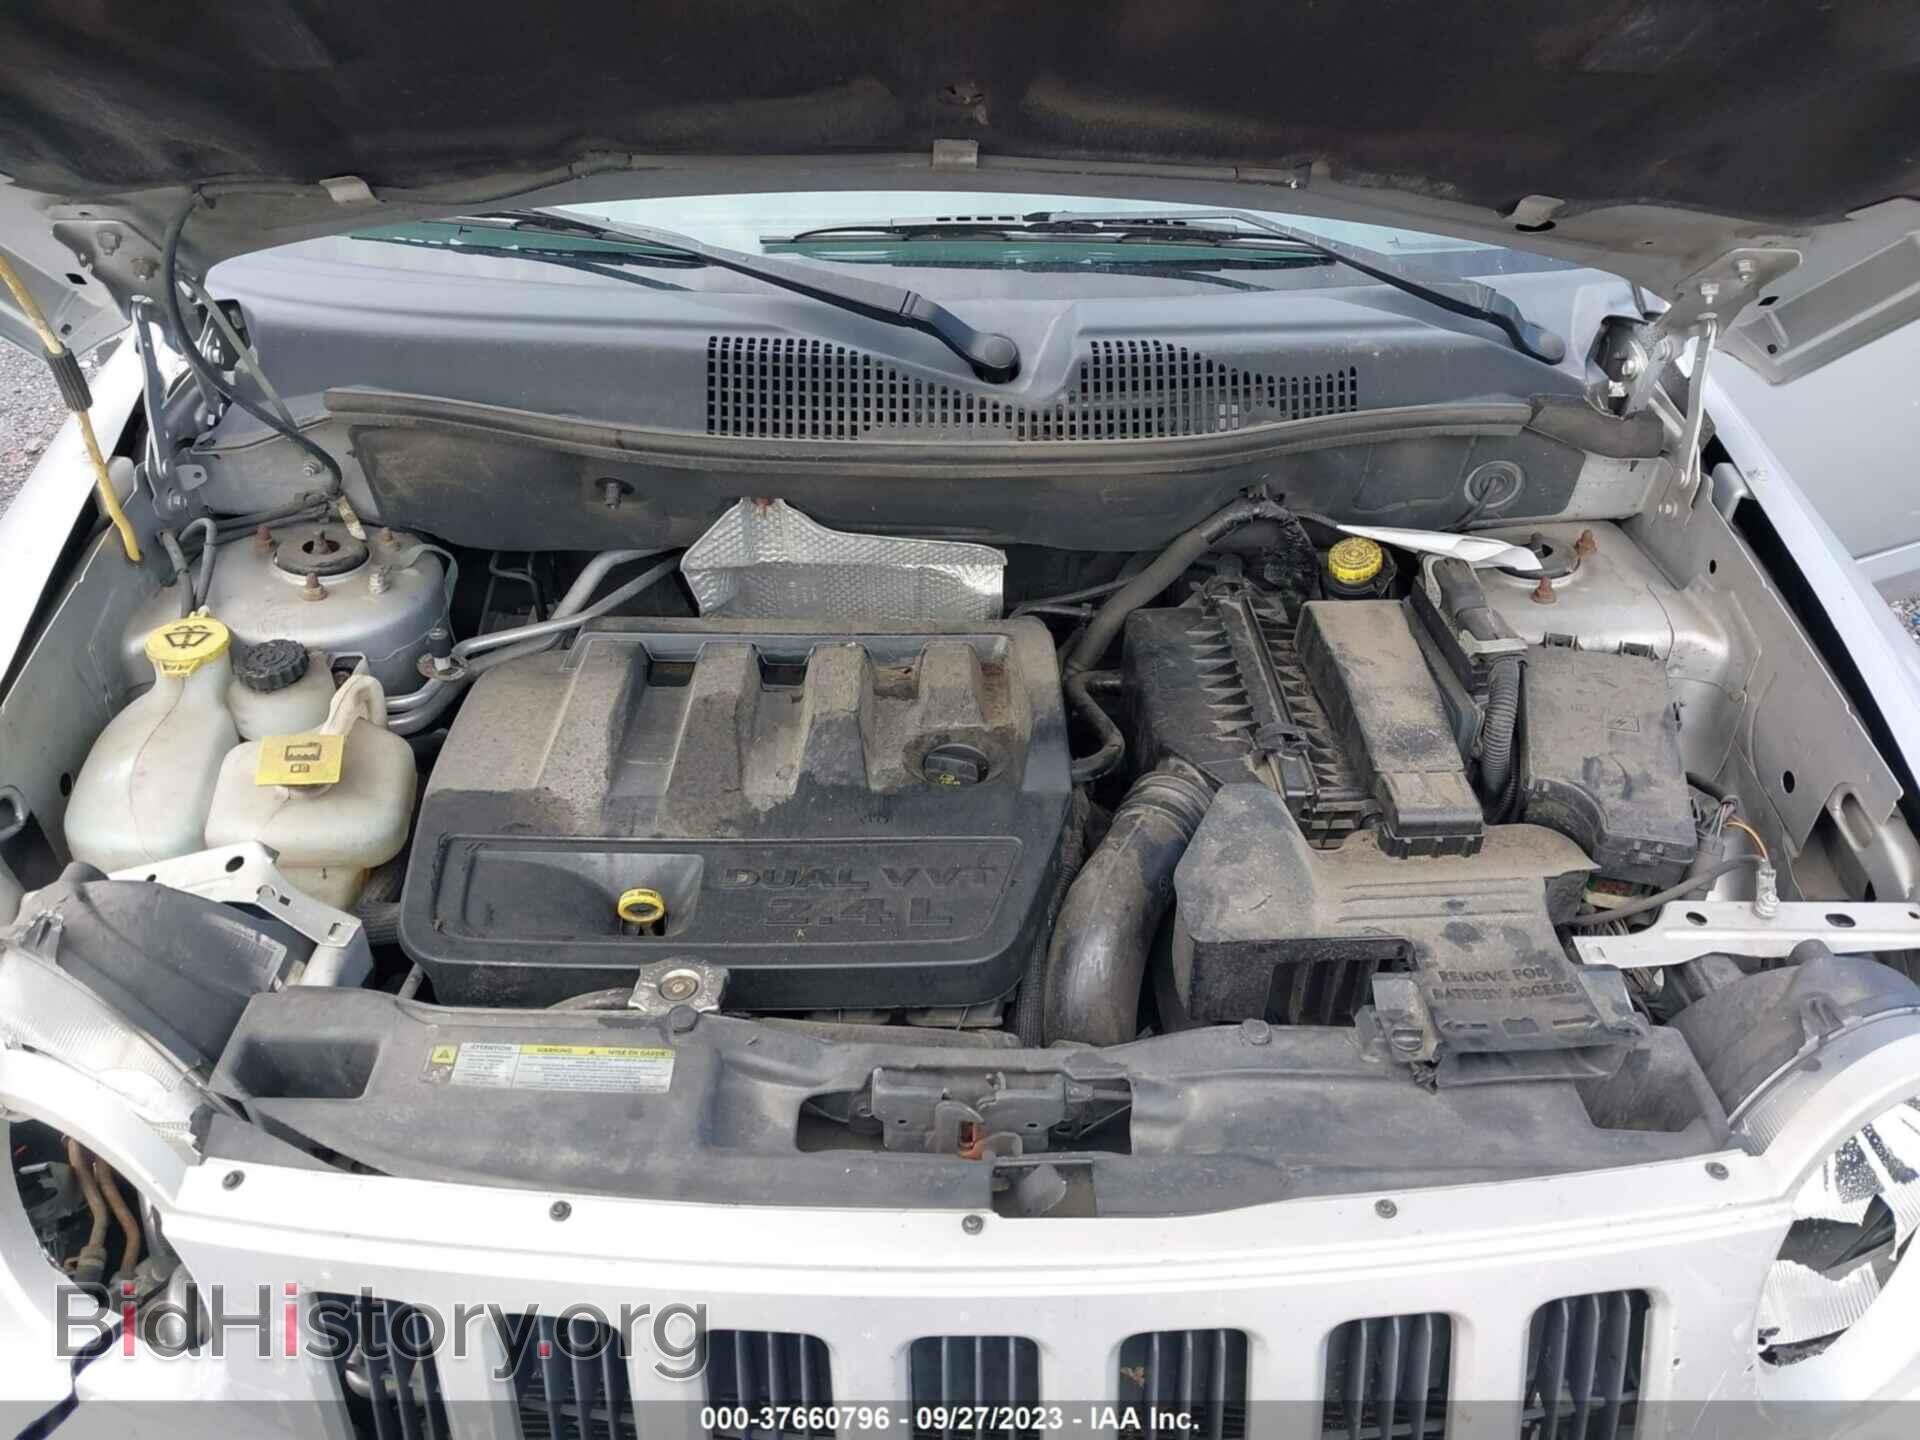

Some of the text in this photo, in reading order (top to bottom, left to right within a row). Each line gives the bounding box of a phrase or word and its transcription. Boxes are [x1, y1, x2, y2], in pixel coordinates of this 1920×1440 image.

[720, 865, 1000, 890] DUAL VVT
[763, 897, 953, 926] 2.4L
[1438, 967, 1549, 983] REMOVE FOR
[1432, 983, 1577, 1000] BATTERY ACCESS
